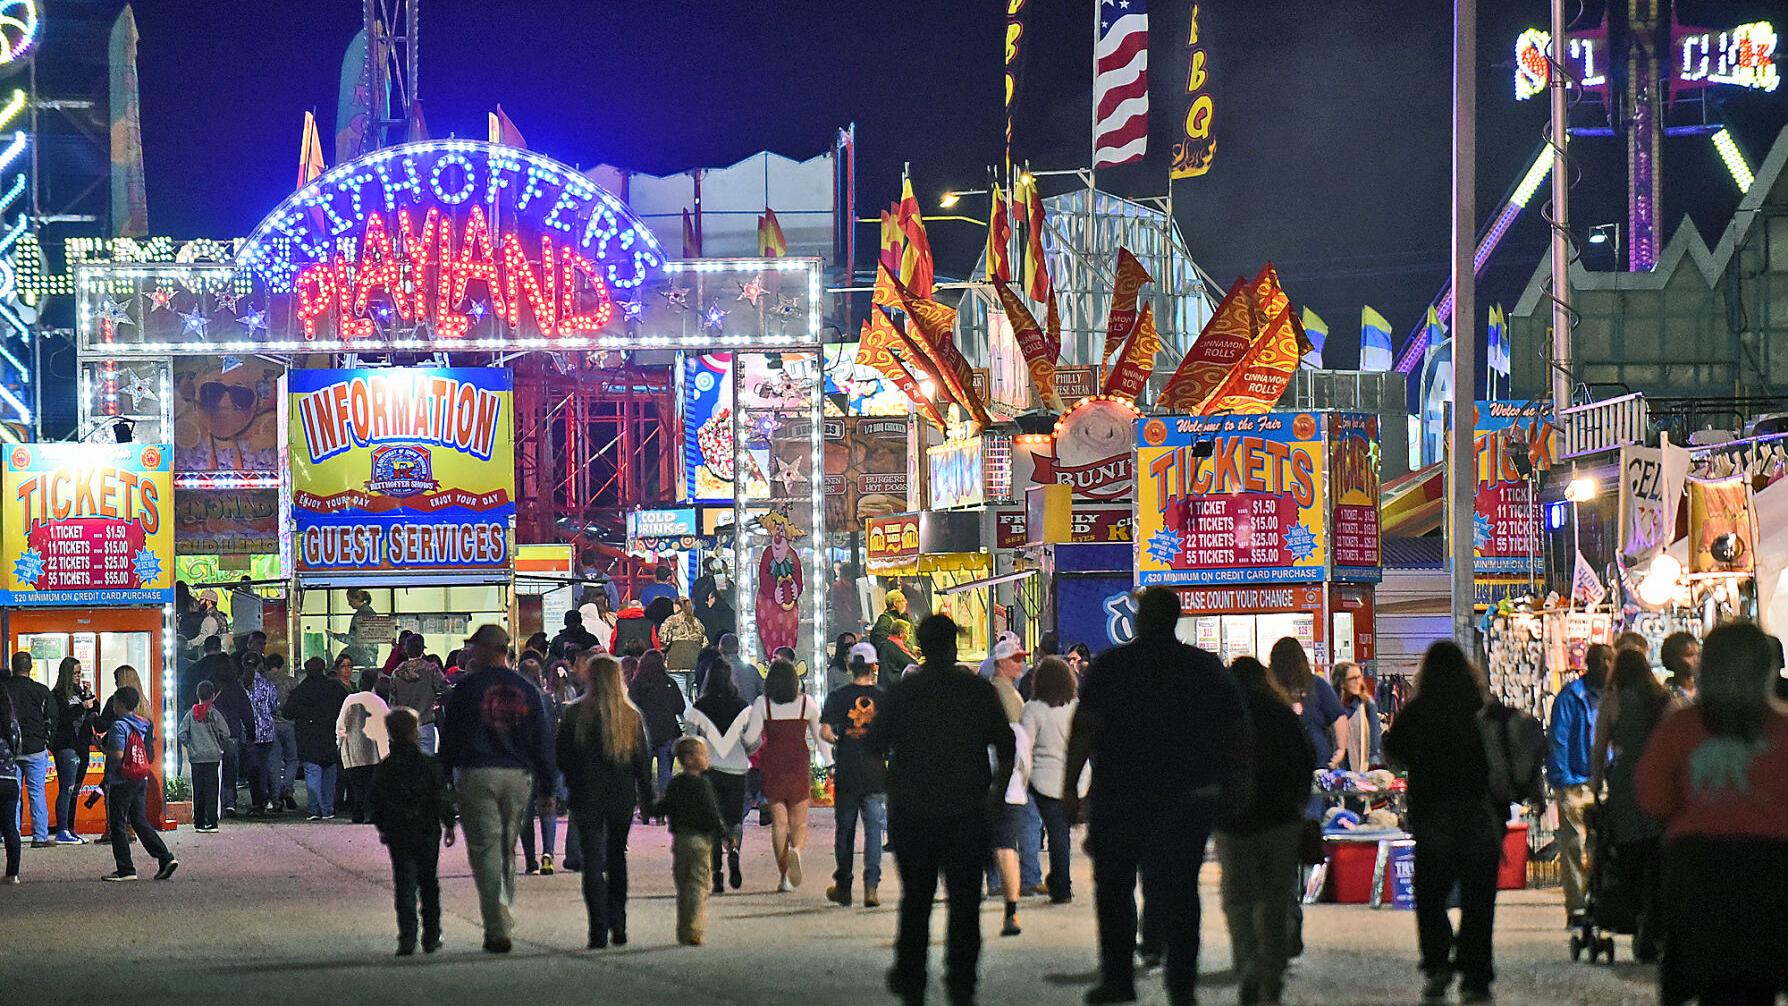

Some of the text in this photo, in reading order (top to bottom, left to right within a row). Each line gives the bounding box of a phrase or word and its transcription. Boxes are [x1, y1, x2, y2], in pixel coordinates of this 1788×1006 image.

[297, 203, 613, 340] PLAYLAND
[1204, 348, 1235, 358] ROLLS
[1055, 374, 1082, 384] PHILLY
[1244, 373, 1287, 385] CINNAMON
[1248, 383, 1278, 394] ROLLS
[301, 375, 500, 460] INFORMATION
[1177, 416, 1282, 433] Welcme to the Fair
[866, 476, 905, 484] BURGERS
[1055, 460, 1132, 487] BUNI
[1151, 436, 1314, 513] TICKETS
[865, 484, 881, 492] HOT
[17, 466, 159, 535] TICKETS
[299, 494, 369, 508] ENJOY YOUR DAY
[430, 494, 498, 507] ENJOY YOUR DAY
[1196, 501, 1226, 514] TICKET
[1253, 500, 1275, 514] $1.50
[641, 512, 677, 522] COLD
[1497, 505, 1506, 518] 11
[639, 522, 689, 534] DRINKS
[1187, 516, 1278, 531] 11 TICKETS $15.00
[1497, 521, 1507, 534] 22
[56, 525, 83, 538] TICKET
[106, 525, 126, 539] $1.50
[305, 522, 505, 565] GUEST SERVICES
[1186, 535, 1196, 548] 22
[1198, 534, 1234, 547] TICKETS
[1251, 532, 1278, 547] $25.00
[1497, 538, 1507, 551] 55
[48, 541, 128, 554] 11 TICKETS $15.00
[48, 557, 57, 569] 22
[58, 556, 90, 569] TICKETS
[104, 556, 128, 570] $25.00
[1186, 549, 1279, 564] 55 TICKETS $55.00
[1511, 560, 1523, 569] ON
[48, 571, 128, 585] 55 TICKETS $55.00
[1148, 569, 1317, 582] $20 MINIMUM ON CREDIT CARD PURCHASE
[14, 591, 161, 602] $20 MINIMUM ON CREDIT CARD PURCHASE
[1178, 591, 1205, 610] LEASE
[1207, 590, 1235, 609] COUNT
[1236, 590, 1259, 609] YOUR
[1260, 589, 1293, 608] CHANGE
